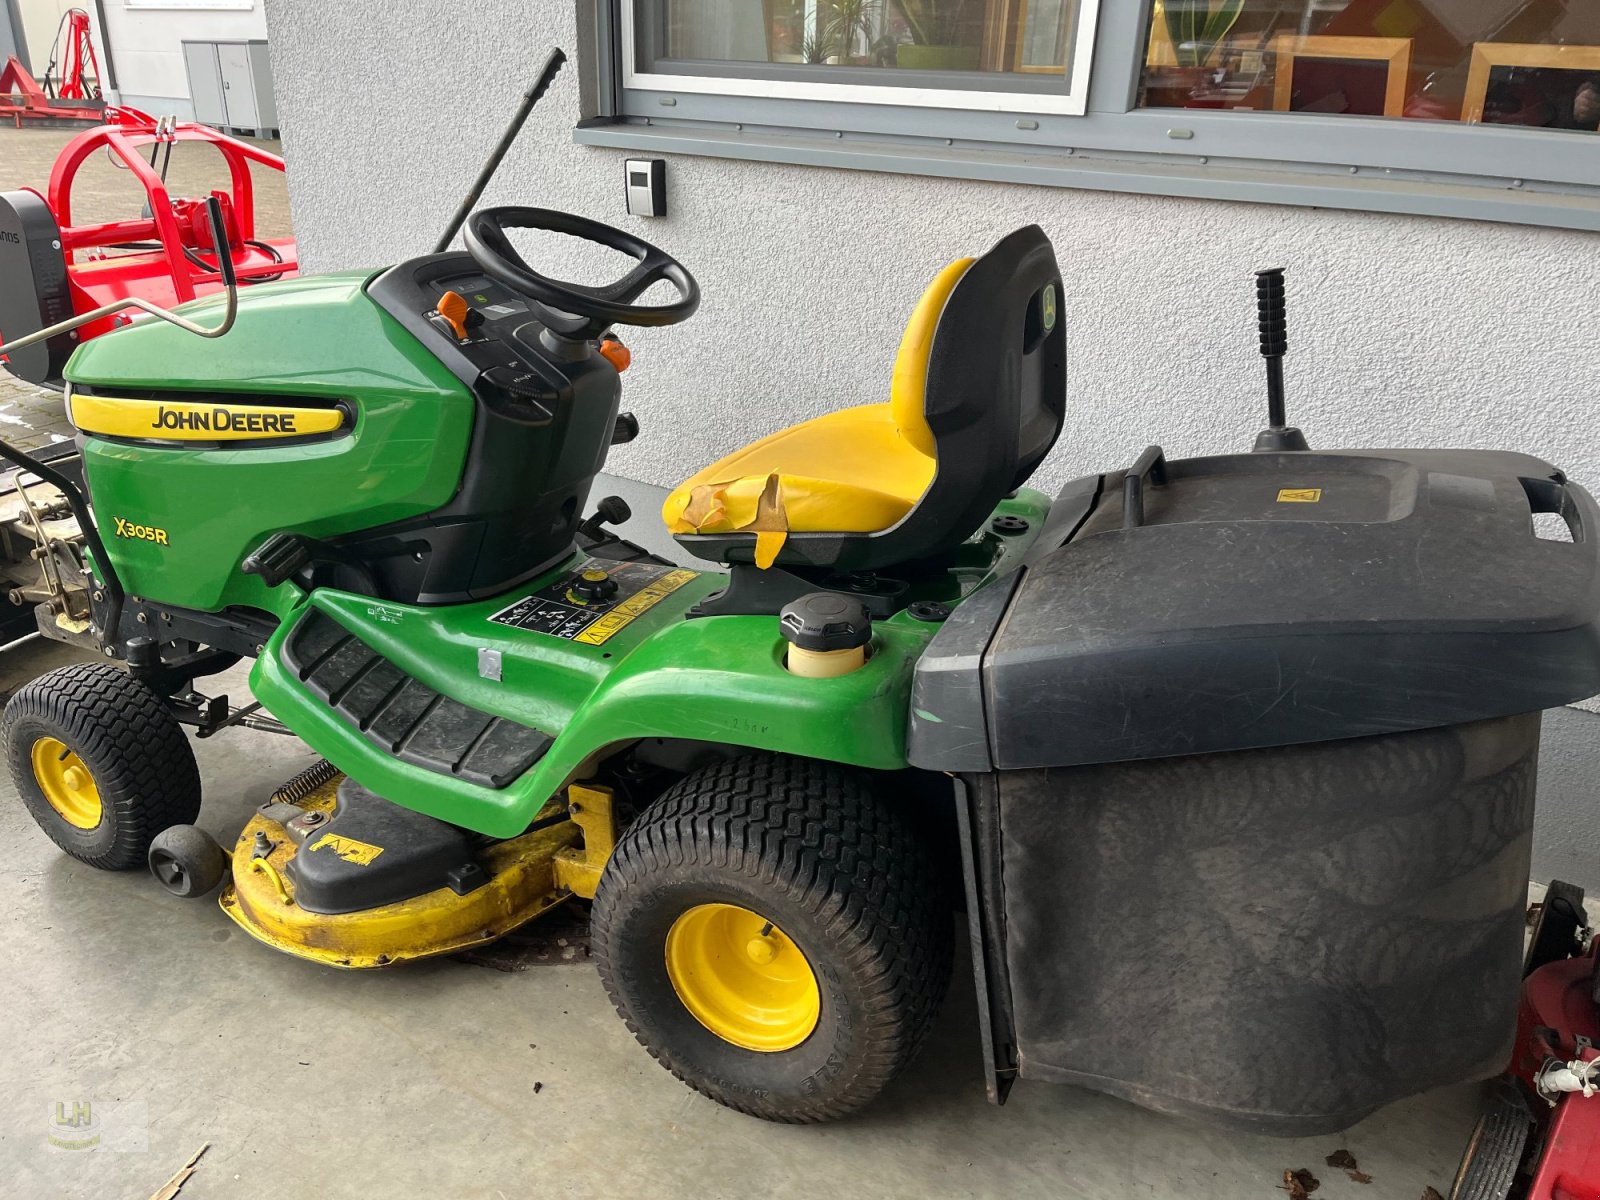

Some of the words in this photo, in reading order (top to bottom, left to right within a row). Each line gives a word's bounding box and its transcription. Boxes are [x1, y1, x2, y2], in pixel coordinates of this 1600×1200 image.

[152, 406, 210, 431] JOHN
[212, 408, 296, 432] DEERE
[113, 515, 169, 545] X305R
